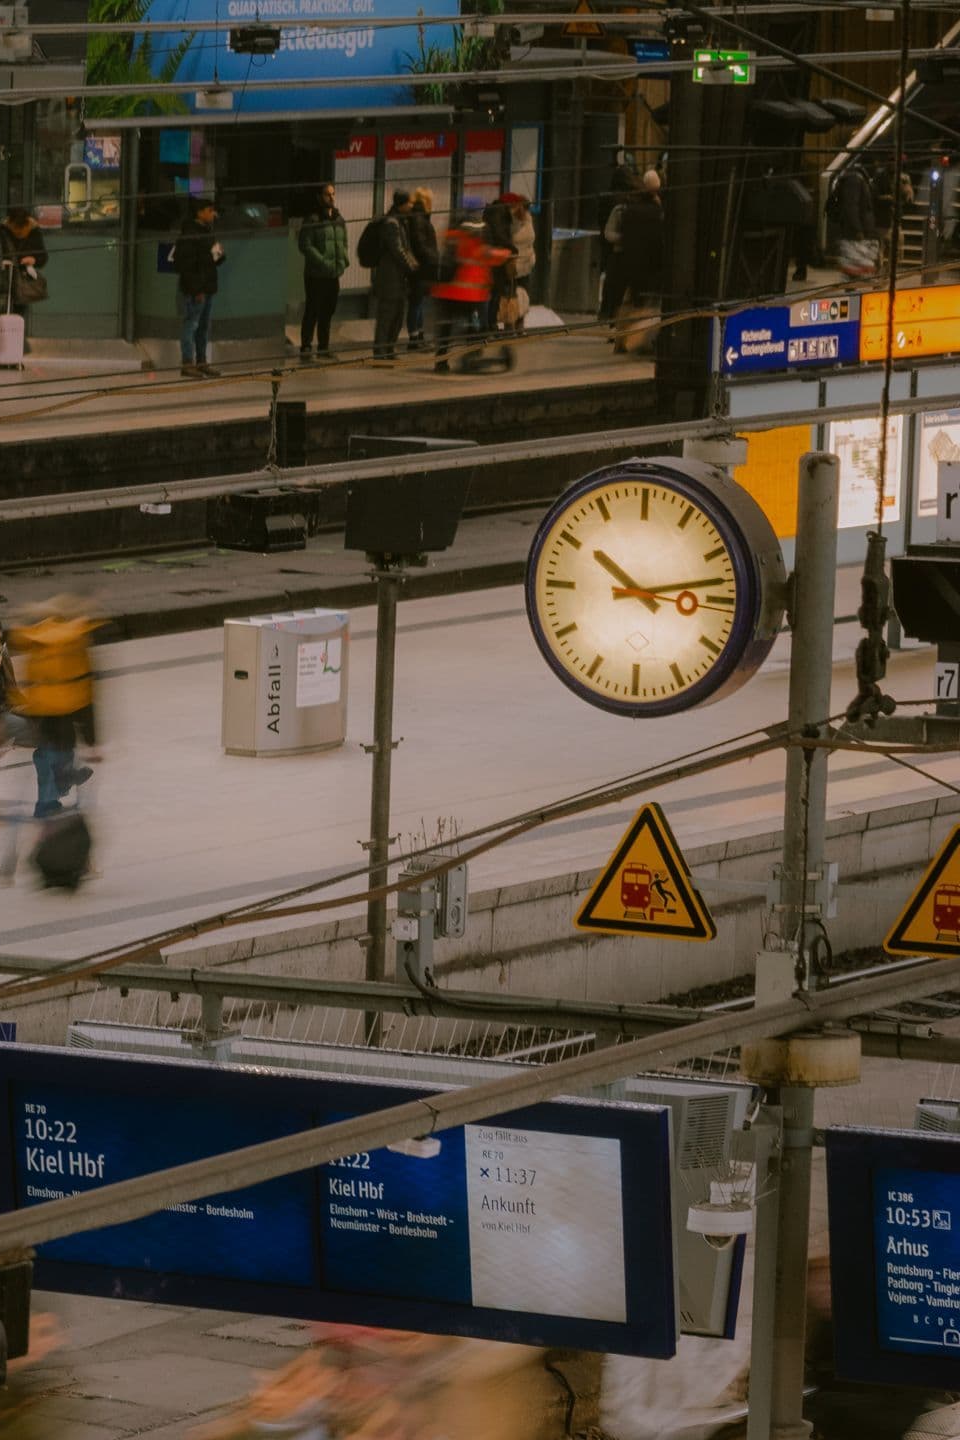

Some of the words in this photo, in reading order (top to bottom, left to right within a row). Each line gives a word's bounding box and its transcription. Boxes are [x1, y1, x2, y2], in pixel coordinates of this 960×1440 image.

[939, 669, 956, 697] r7
[266, 664, 282, 735] Abfall
[25, 1103, 36, 1114] RE
[25, 1118, 77, 1144] 10:22
[26, 1147, 65, 1175] Kiel
[69, 1151, 105, 1179] Hbf
[496, 1167, 537, 1187] 11:37
[329, 1178, 357, 1198] Kiel
[359, 1181, 385, 1200] Hbf
[888, 1191, 897, 1201] IC
[206, 1204, 255, 1220] Bordesholm
[329, 1203, 369, 1218] Elmshorn
[376, 1207, 399, 1221] Wrist
[406, 1210, 448, 1227] Brokstedt
[481, 1194, 537, 1216] Ankunft
[885, 1207, 931, 1228] 10:53
[330, 1218, 381, 1233] Neumünster
[388, 1223, 439, 1239] Bordesholm
[886, 1235, 930, 1257] Århus
[886, 1262, 934, 1280] Rendsburg
[887, 1276, 924, 1293] Padborg
[887, 1290, 918, 1306] Vojens
